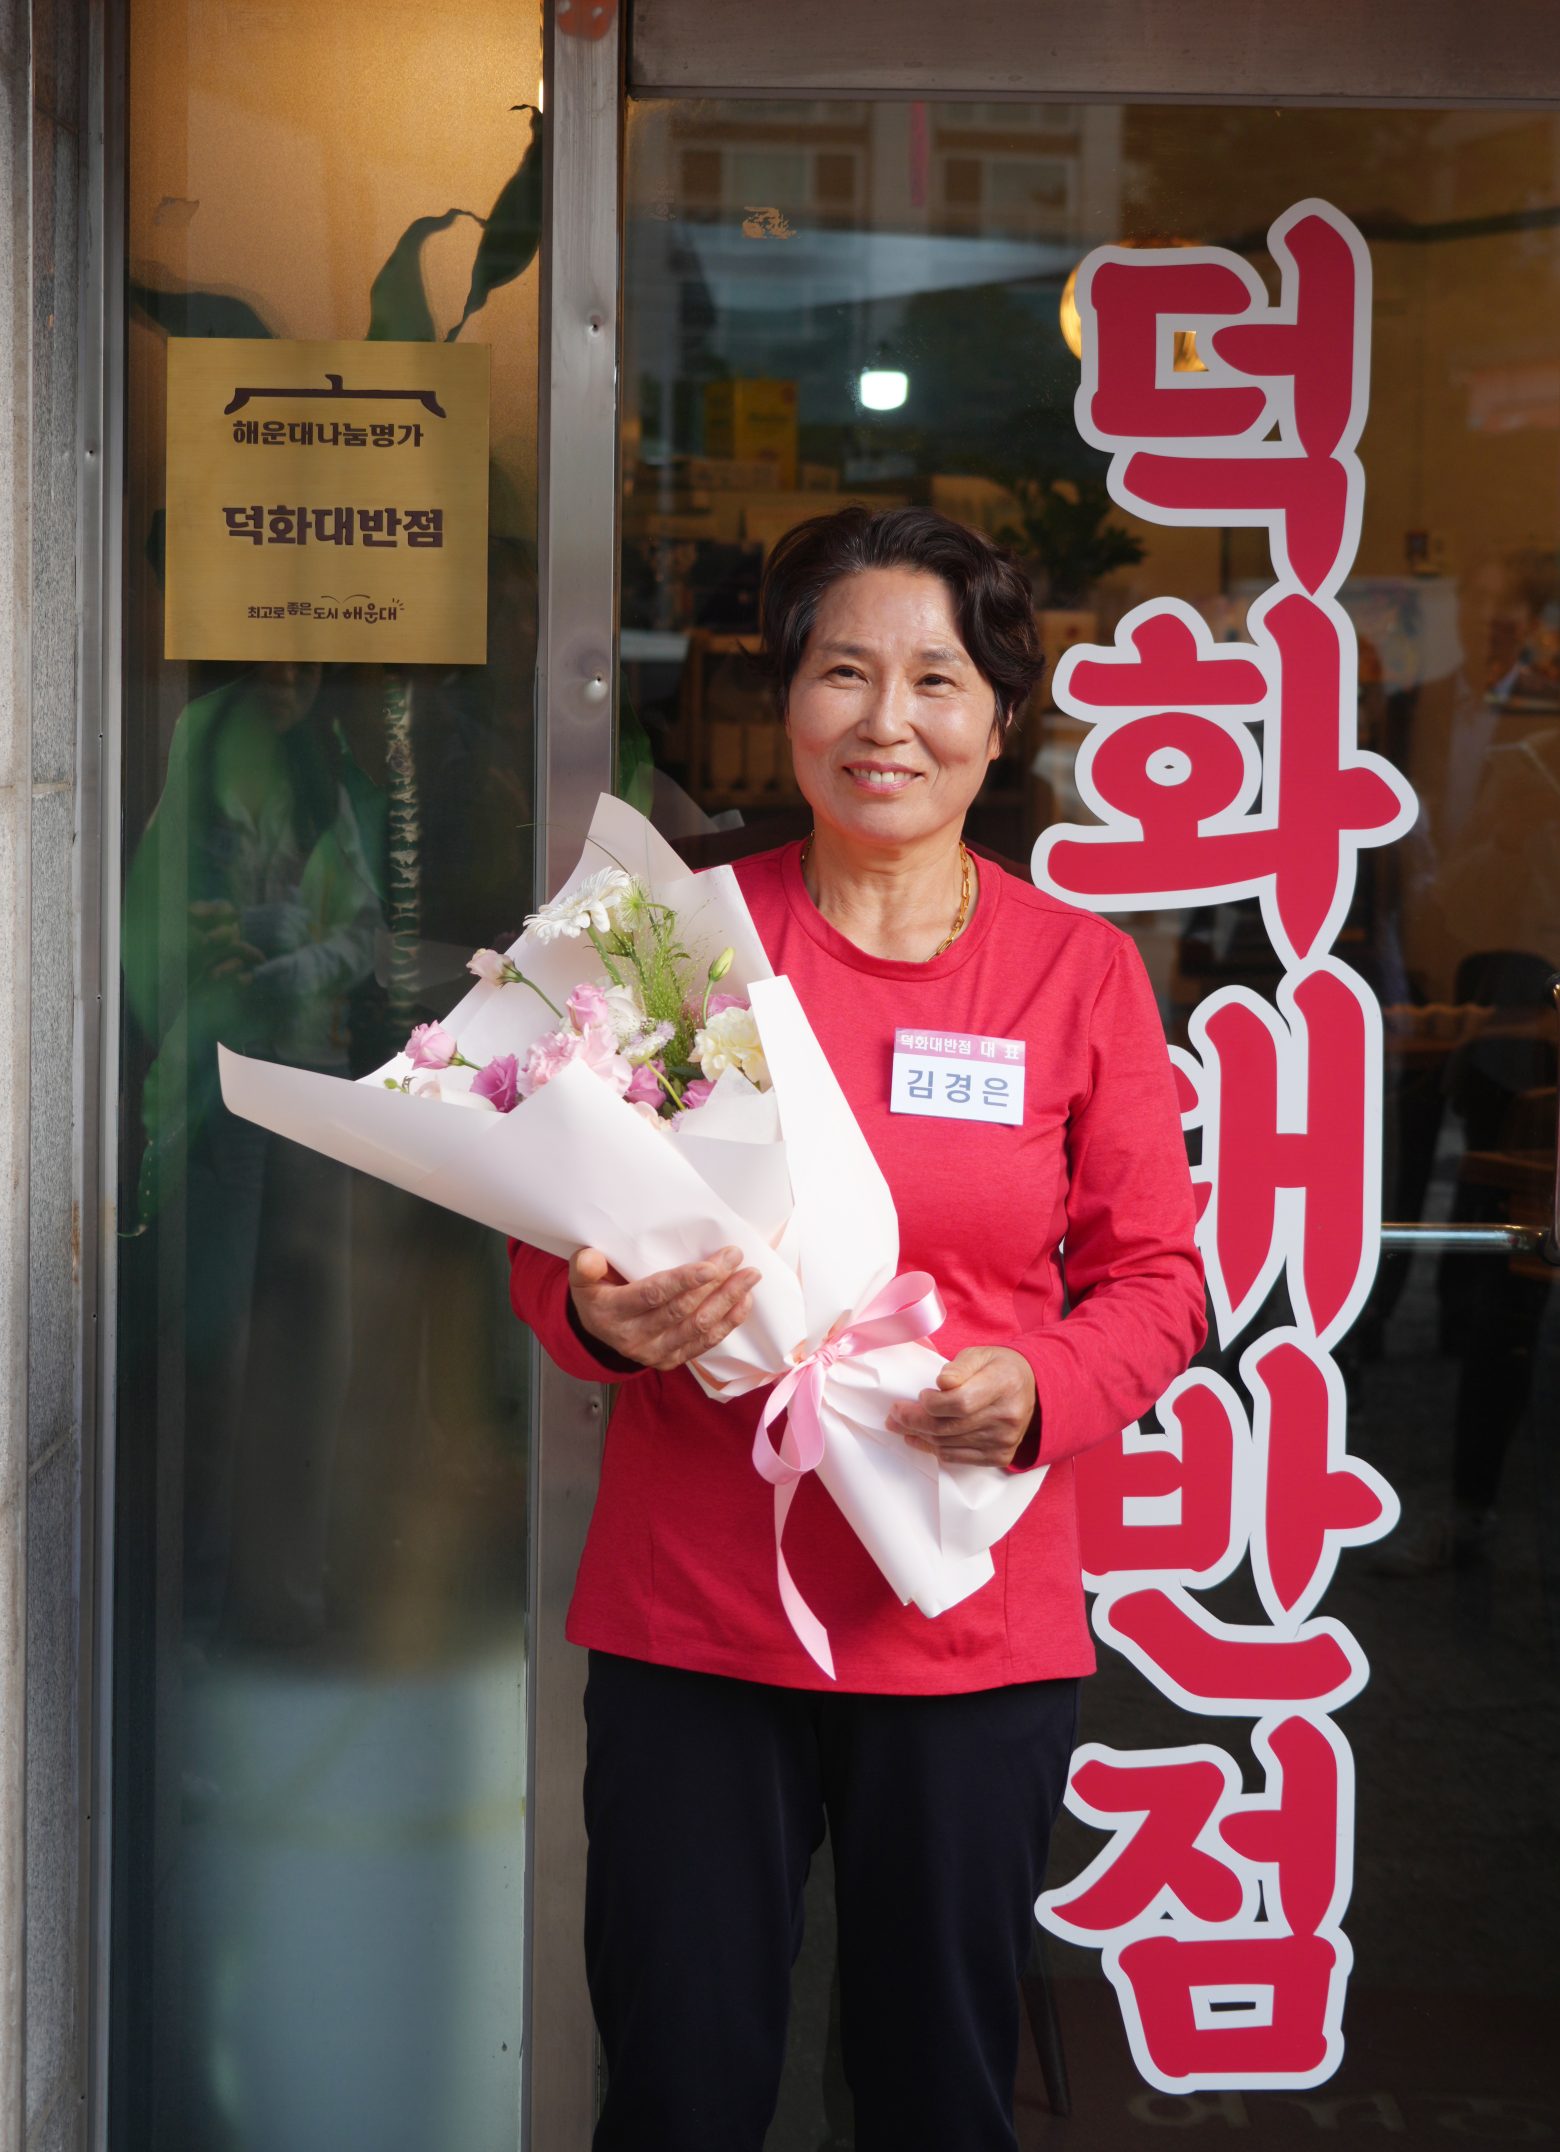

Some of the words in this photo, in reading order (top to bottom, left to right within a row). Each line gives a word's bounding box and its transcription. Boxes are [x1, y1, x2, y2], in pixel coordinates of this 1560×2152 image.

[232, 420, 424, 448] 해운대나눔명가
[222, 504, 444, 548] 덕화대반점
[342, 602, 398, 624] 해운대
[900, 1034, 972, 1056] 덕화대반점
[907, 1069, 1010, 1107] 김경은
